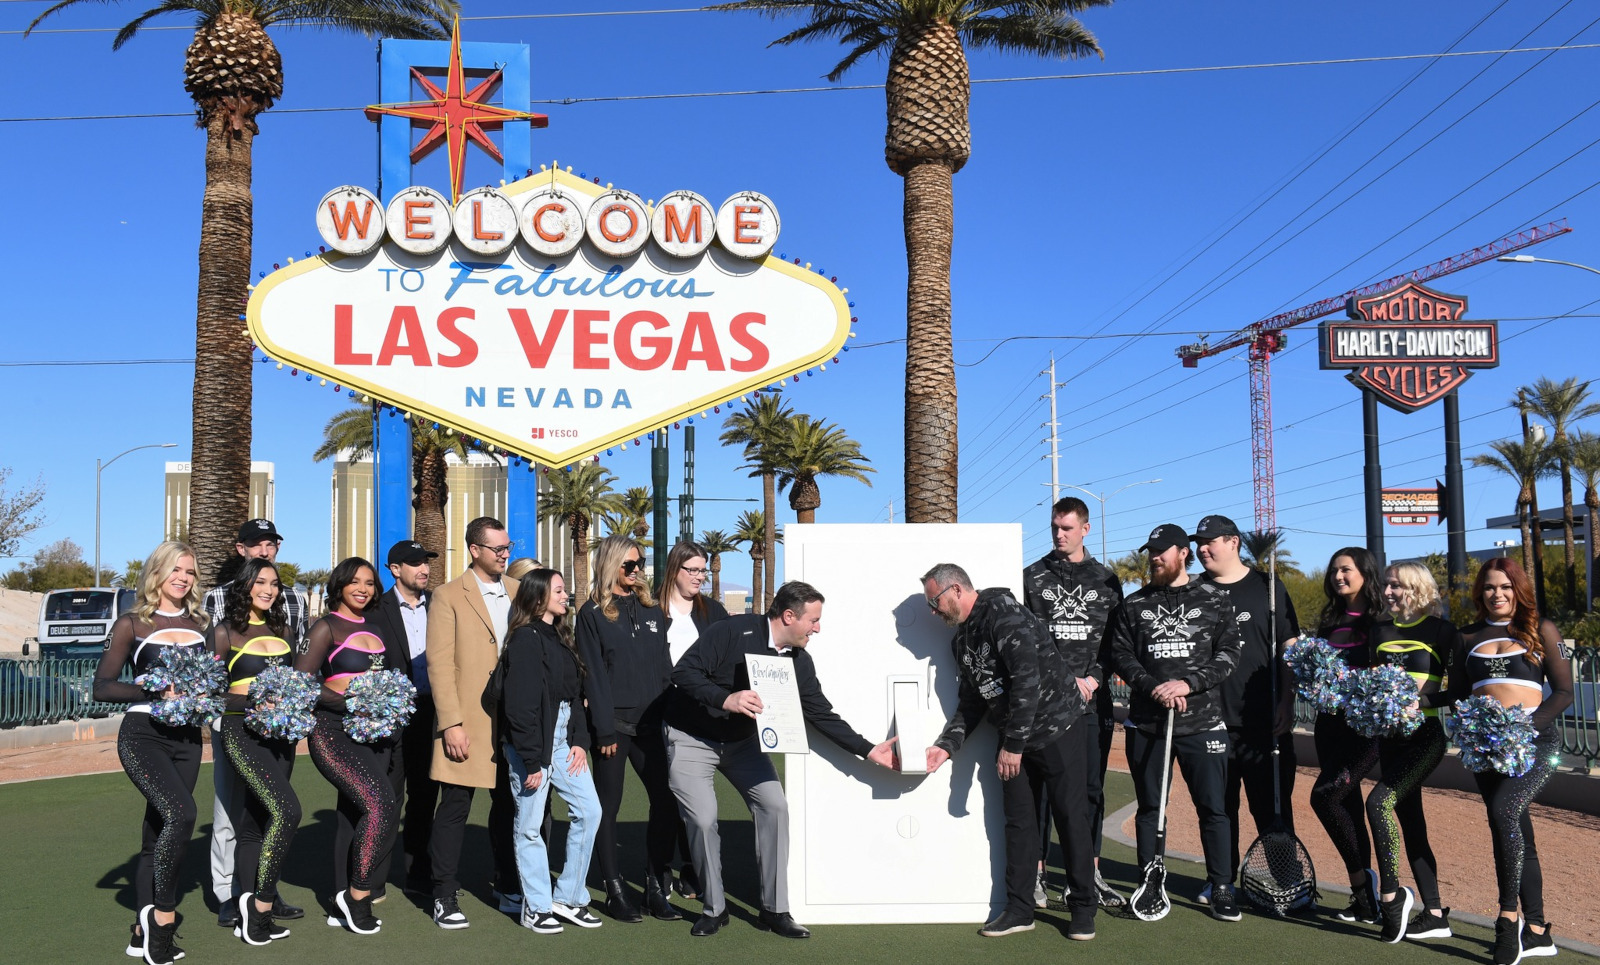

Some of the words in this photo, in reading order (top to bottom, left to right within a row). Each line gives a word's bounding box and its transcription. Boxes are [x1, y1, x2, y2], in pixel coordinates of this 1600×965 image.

[326, 198, 765, 246] WELCOME
[377, 268, 425, 292] TO
[444, 261, 715, 302] Fabulous
[1371, 290, 1452, 321] MOTOR
[333, 304, 479, 369] LAS
[507, 308, 771, 372] VEGAS
[1337, 330, 1489, 357] HARLEY-DAVIDSON
[1373, 366, 1453, 399] CYCLES
[464, 386, 633, 410] NEVADA
[548, 429, 579, 438] YESCO
[1381, 493, 1439, 501] RECHARGE
[50, 626, 69, 636] DEUCE
[1048, 624, 1093, 633] DESERT
[1054, 632, 1088, 641] DOGS
[1147, 642, 1197, 652] DESERT
[1153, 650, 1190, 659] DOGS
